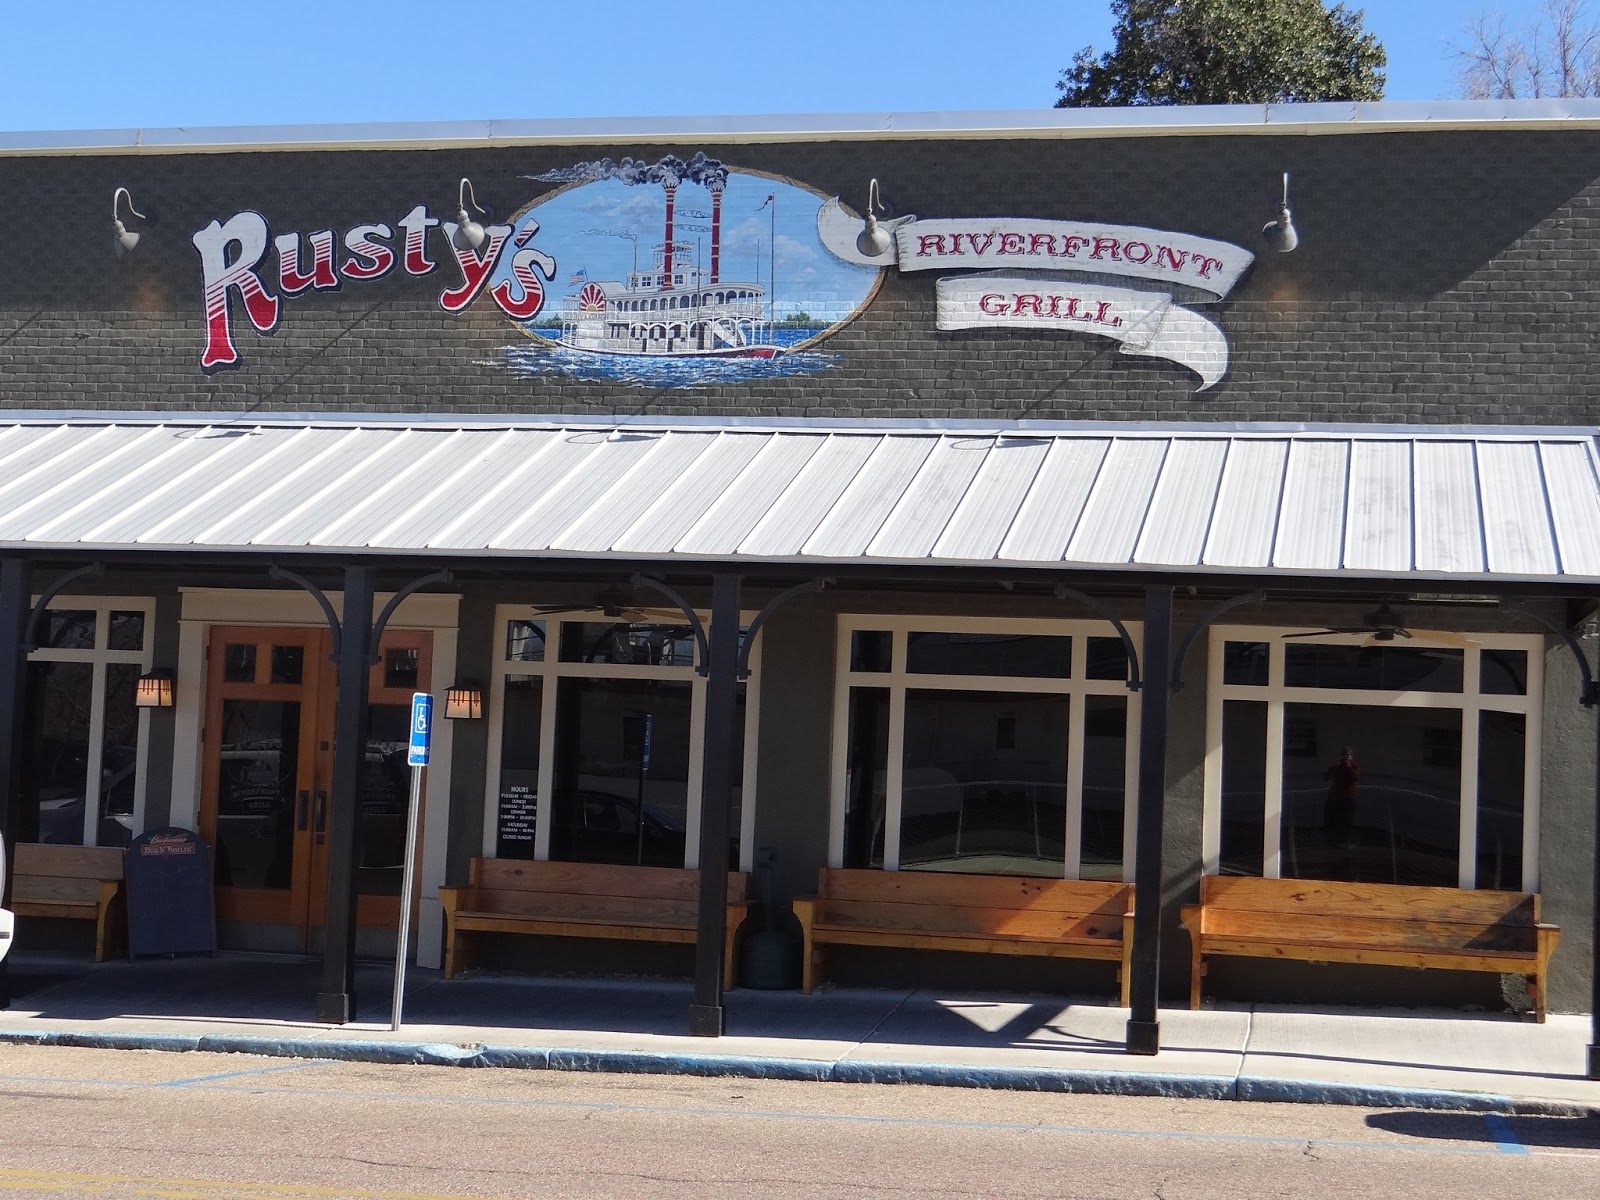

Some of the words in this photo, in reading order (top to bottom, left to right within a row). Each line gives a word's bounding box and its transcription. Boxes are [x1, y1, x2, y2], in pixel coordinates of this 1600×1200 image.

[916, 232, 1223, 280] RIVERFRONT
[192, 205, 556, 374] Rusty's
[979, 293, 1122, 328] GRILL
